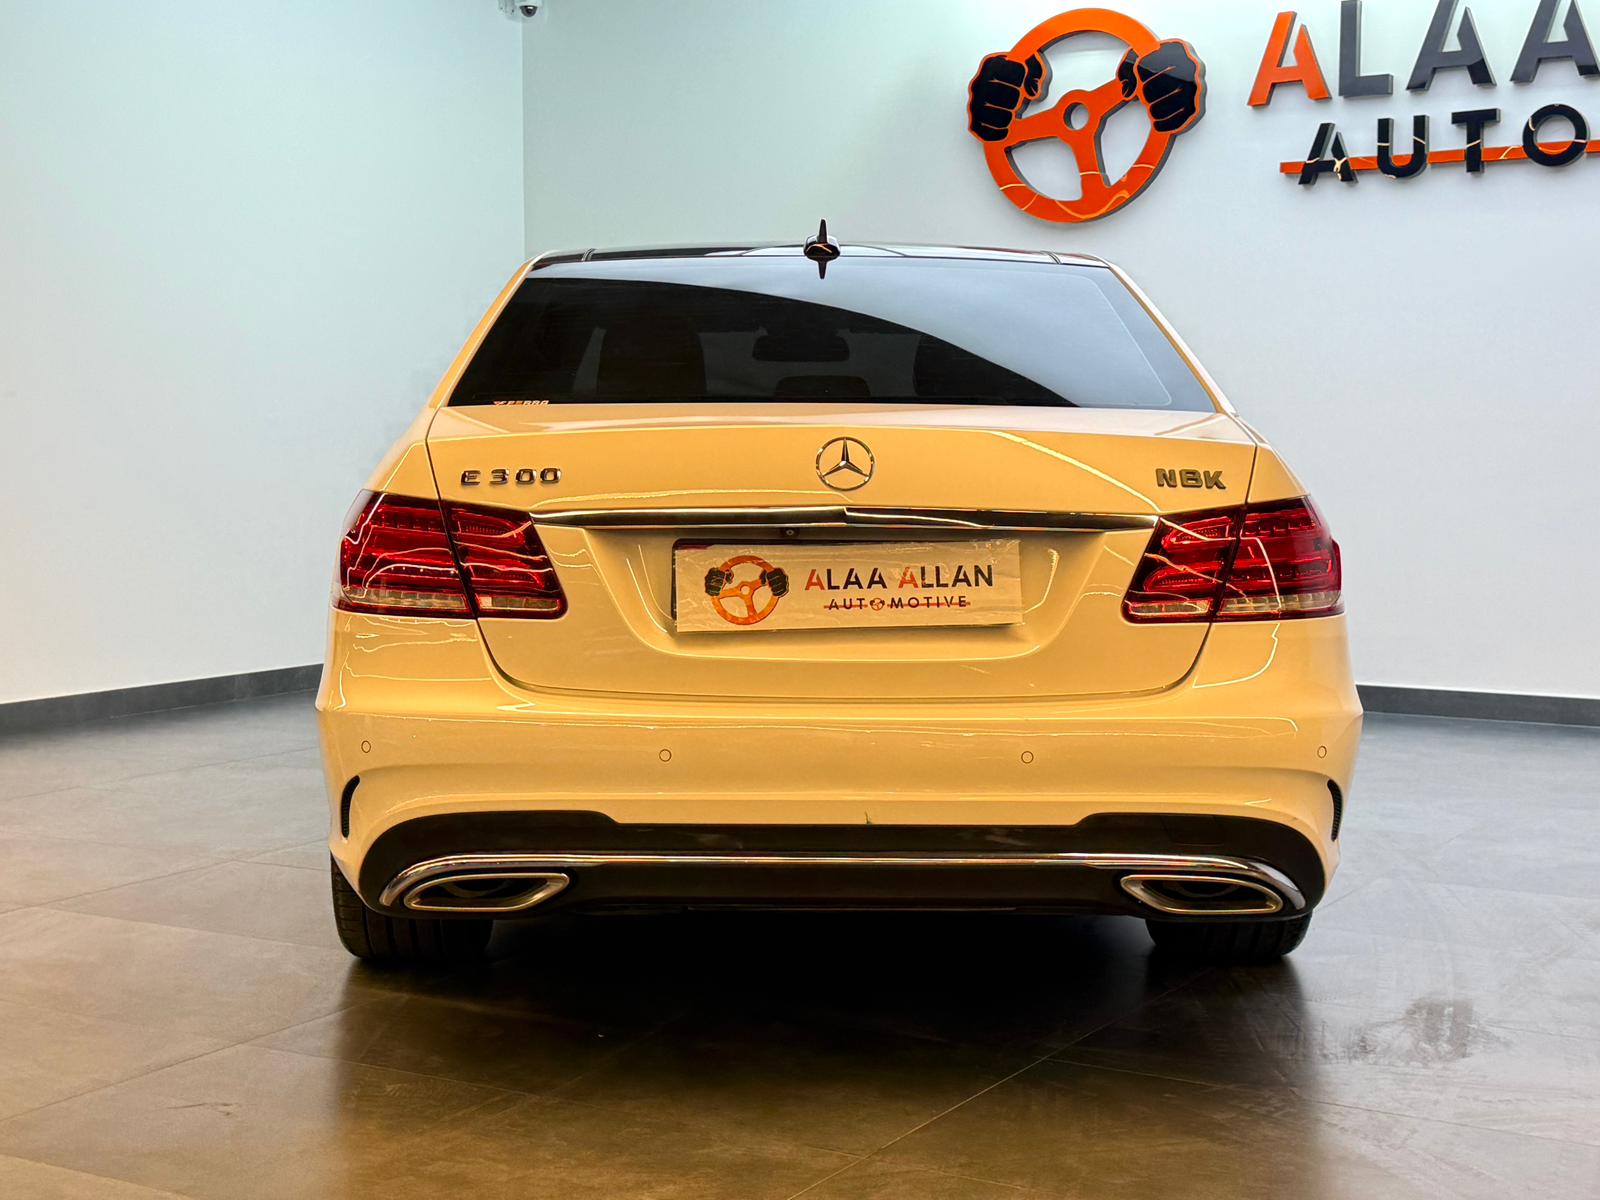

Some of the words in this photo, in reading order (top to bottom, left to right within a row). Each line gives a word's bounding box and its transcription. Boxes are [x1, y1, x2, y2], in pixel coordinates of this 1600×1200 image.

[1247, 0, 1600, 107] ALAA
[1298, 103, 1591, 185] AUTO
[460, 469, 481, 486] E
[489, 467, 561, 485] 300
[1155, 468, 1226, 489] NBK
[804, 567, 888, 591] ALAA
[898, 564, 994, 589] ALLAN
